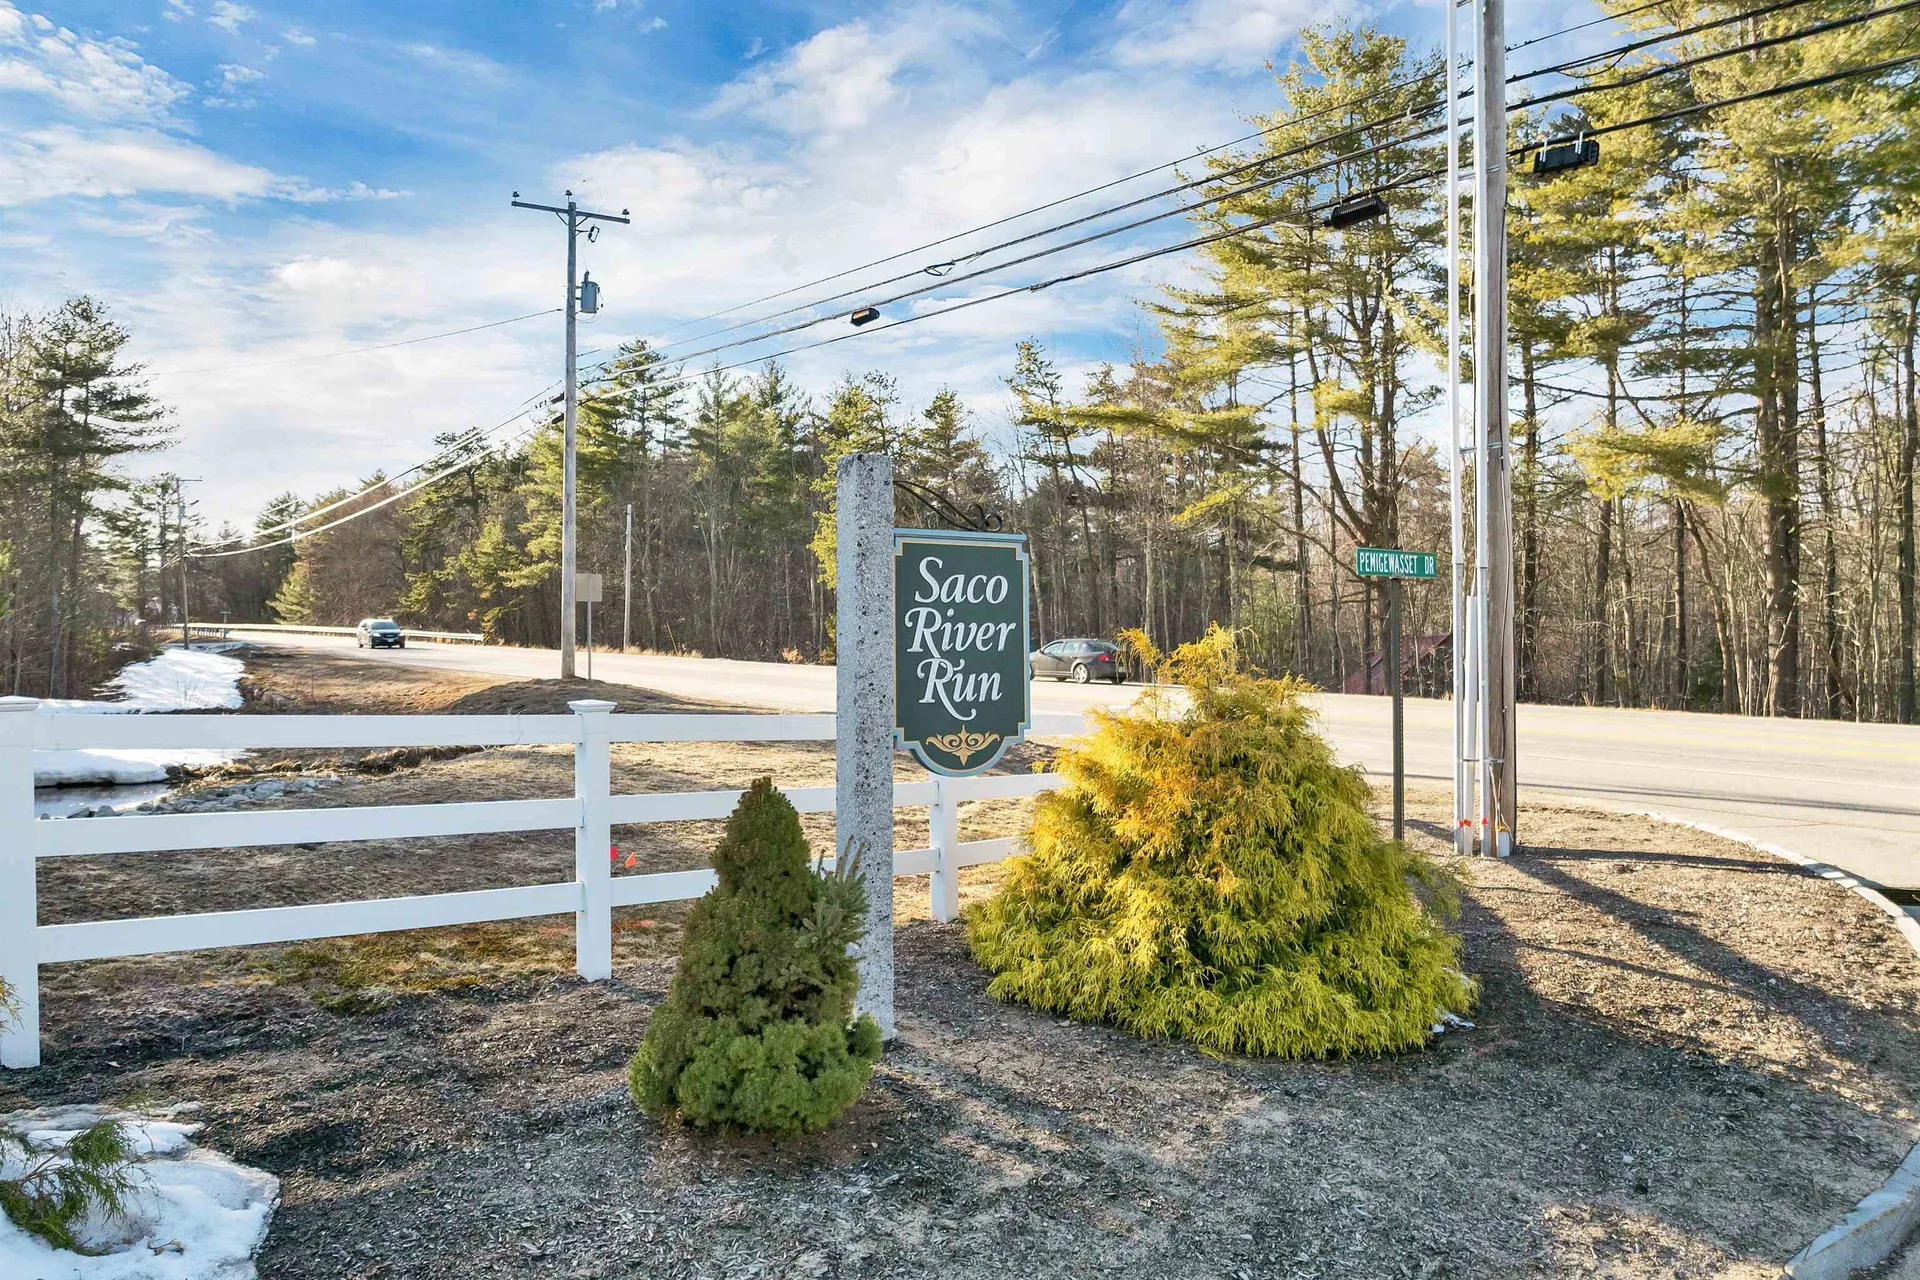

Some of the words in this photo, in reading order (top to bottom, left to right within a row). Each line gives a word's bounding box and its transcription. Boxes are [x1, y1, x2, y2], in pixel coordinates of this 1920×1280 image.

[914, 556, 1009, 604] Saco
[1359, 552, 1417, 574] PEMIGEWASSET
[1424, 555, 1434, 575] DR
[904, 606, 1017, 671] River
[916, 658, 1003, 721] Run
